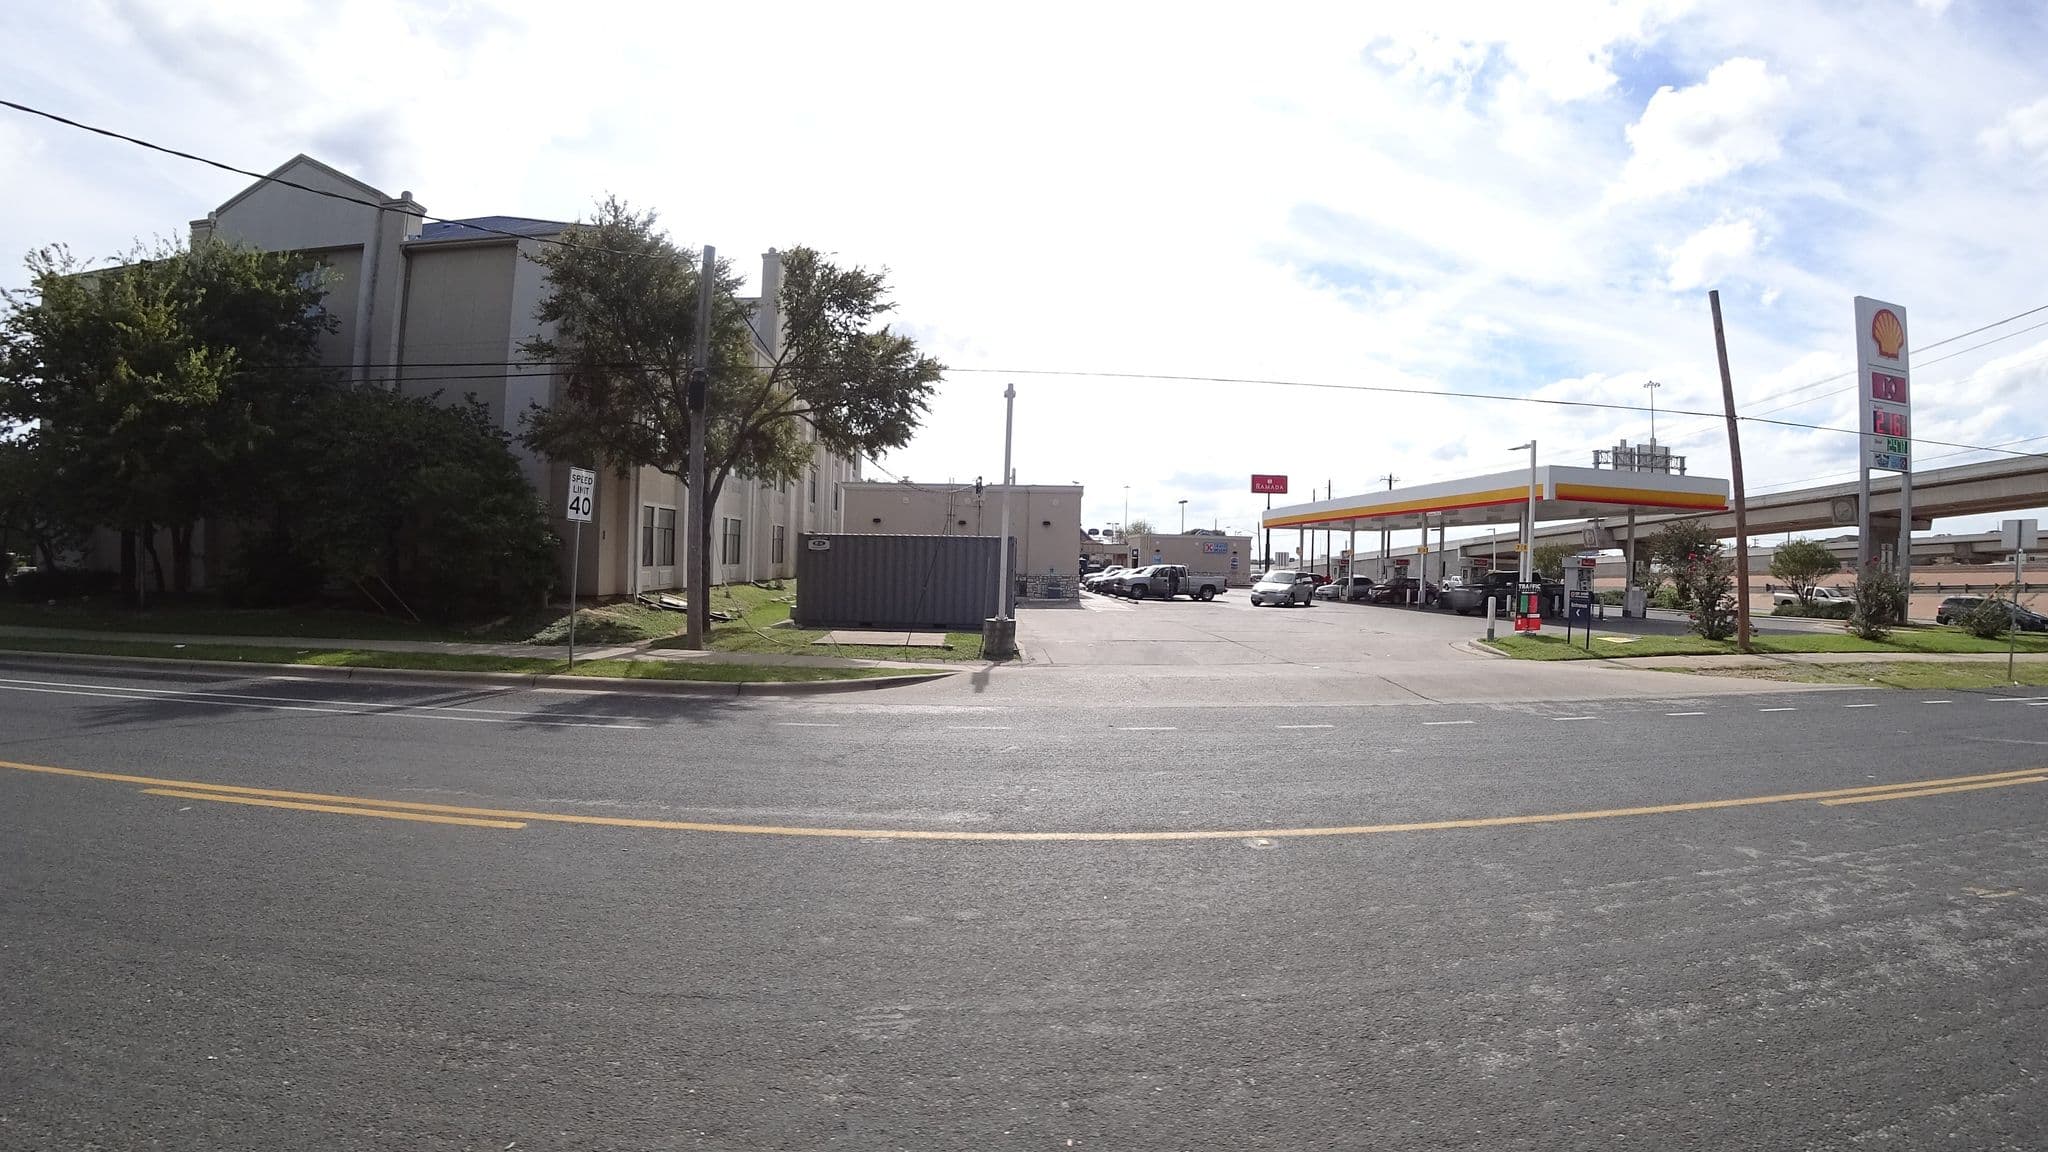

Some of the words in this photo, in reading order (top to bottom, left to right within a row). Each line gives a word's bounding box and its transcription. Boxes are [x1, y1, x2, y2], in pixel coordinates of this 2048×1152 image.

[571, 474, 593, 485] SPEED
[573, 485, 590, 495] LIMIT
[569, 496, 591, 515] 40
